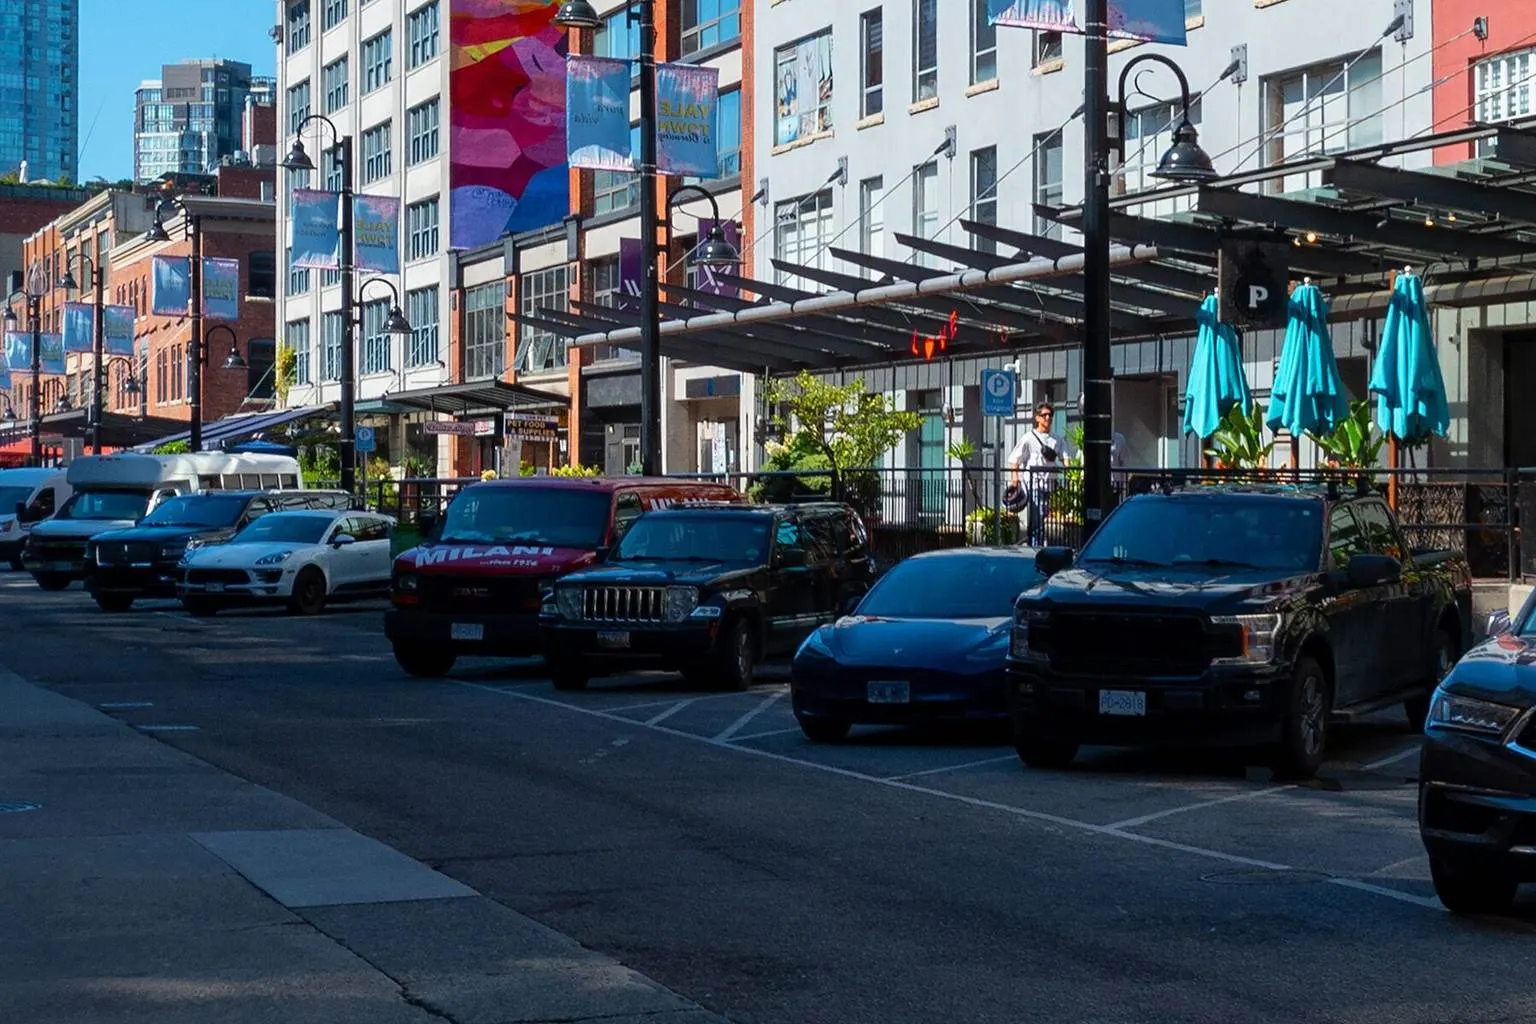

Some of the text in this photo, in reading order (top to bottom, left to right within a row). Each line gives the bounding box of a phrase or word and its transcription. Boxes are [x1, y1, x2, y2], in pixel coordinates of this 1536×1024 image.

[1248, 284, 1269, 309] P
[994, 377, 1005, 393] P
[524, 420, 546, 429] FOOD
[415, 545, 554, 568] MILANI
